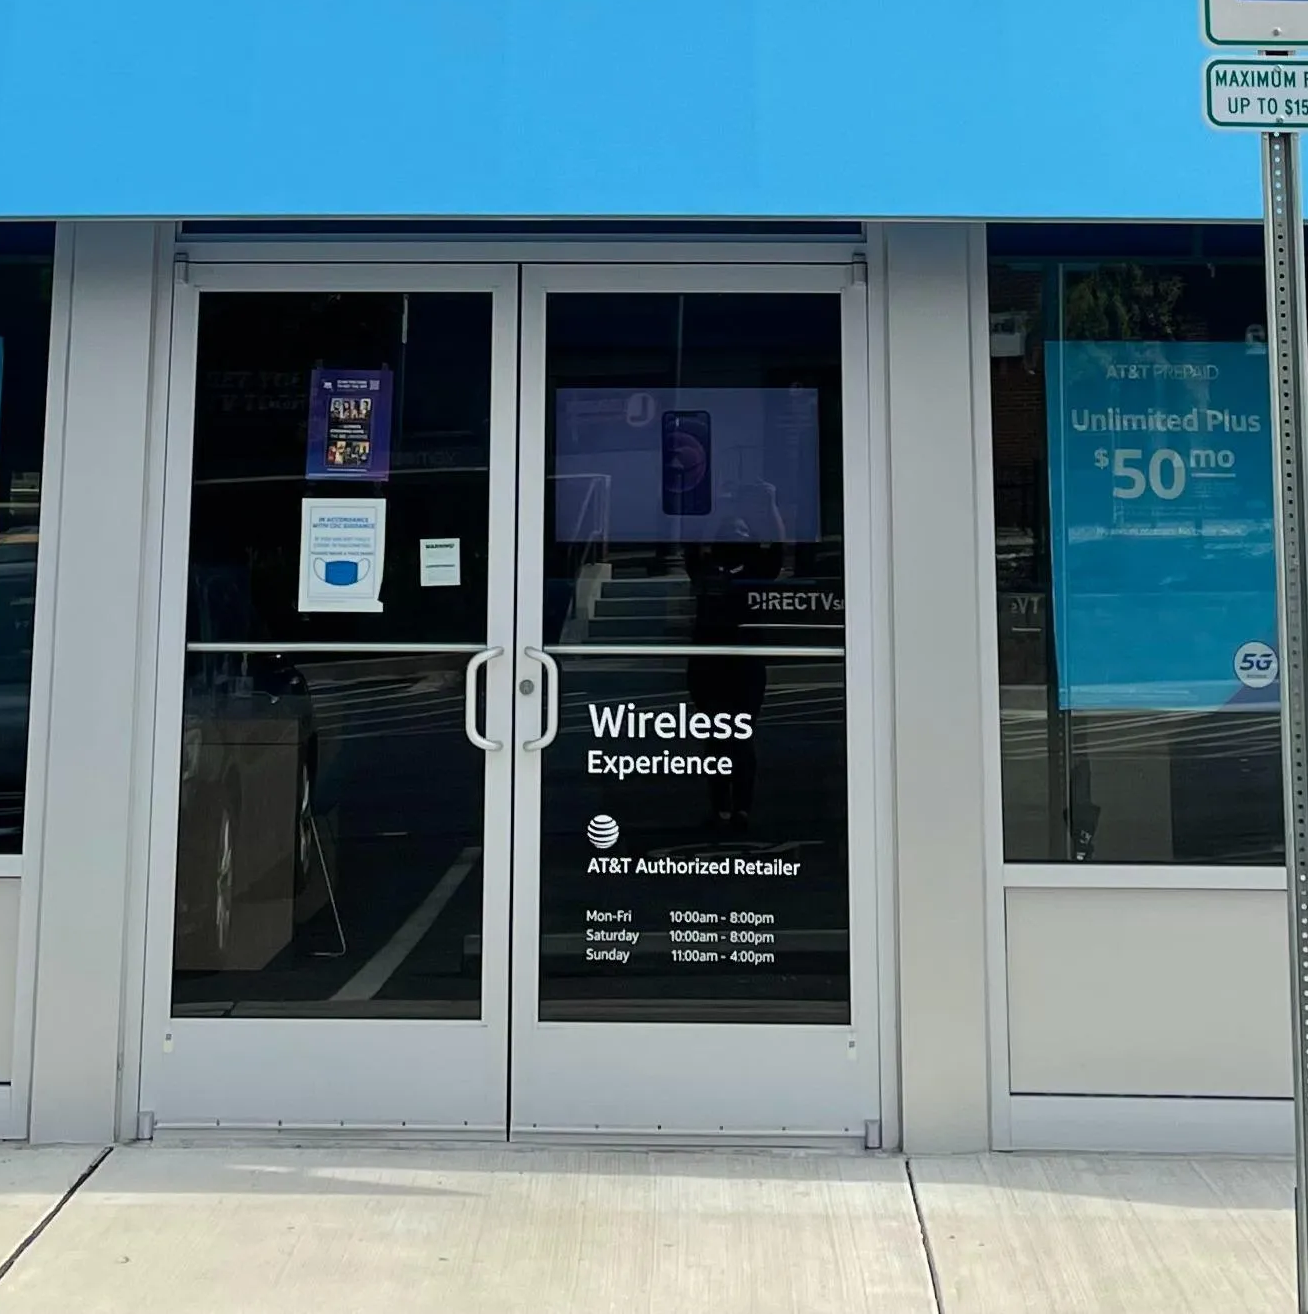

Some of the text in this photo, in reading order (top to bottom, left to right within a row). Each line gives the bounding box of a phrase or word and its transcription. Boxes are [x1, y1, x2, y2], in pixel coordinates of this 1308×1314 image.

[1215, 70, 1296, 88] MAXIMUM
[1227, 97, 1250, 115] UP
[1257, 97, 1278, 115] TO
[1106, 364, 1220, 380] AT&T PREPAID
[1071, 407, 1261, 433] Unlimited Plus
[1094, 447, 1186, 501] $50
[1190, 449, 1236, 469] mo
[1239, 653, 1273, 671] 5G
[588, 703, 753, 739] Wireless
[587, 750, 733, 780] Experience
[587, 857, 801, 876] AT&T Authorized Retailer
[586, 910, 632, 922] Mon-Fri
[669, 911, 718, 923] 10:00am
[729, 911, 775, 927] 8:00pm
[586, 929, 639, 945] Saturday
[669, 930, 718, 943] 10:00am
[729, 930, 775, 945] 8:00pm
[586, 949, 630, 964] Sunday
[671, 950, 718, 962] 11:00am
[729, 950, 775, 966] 4:00pm
